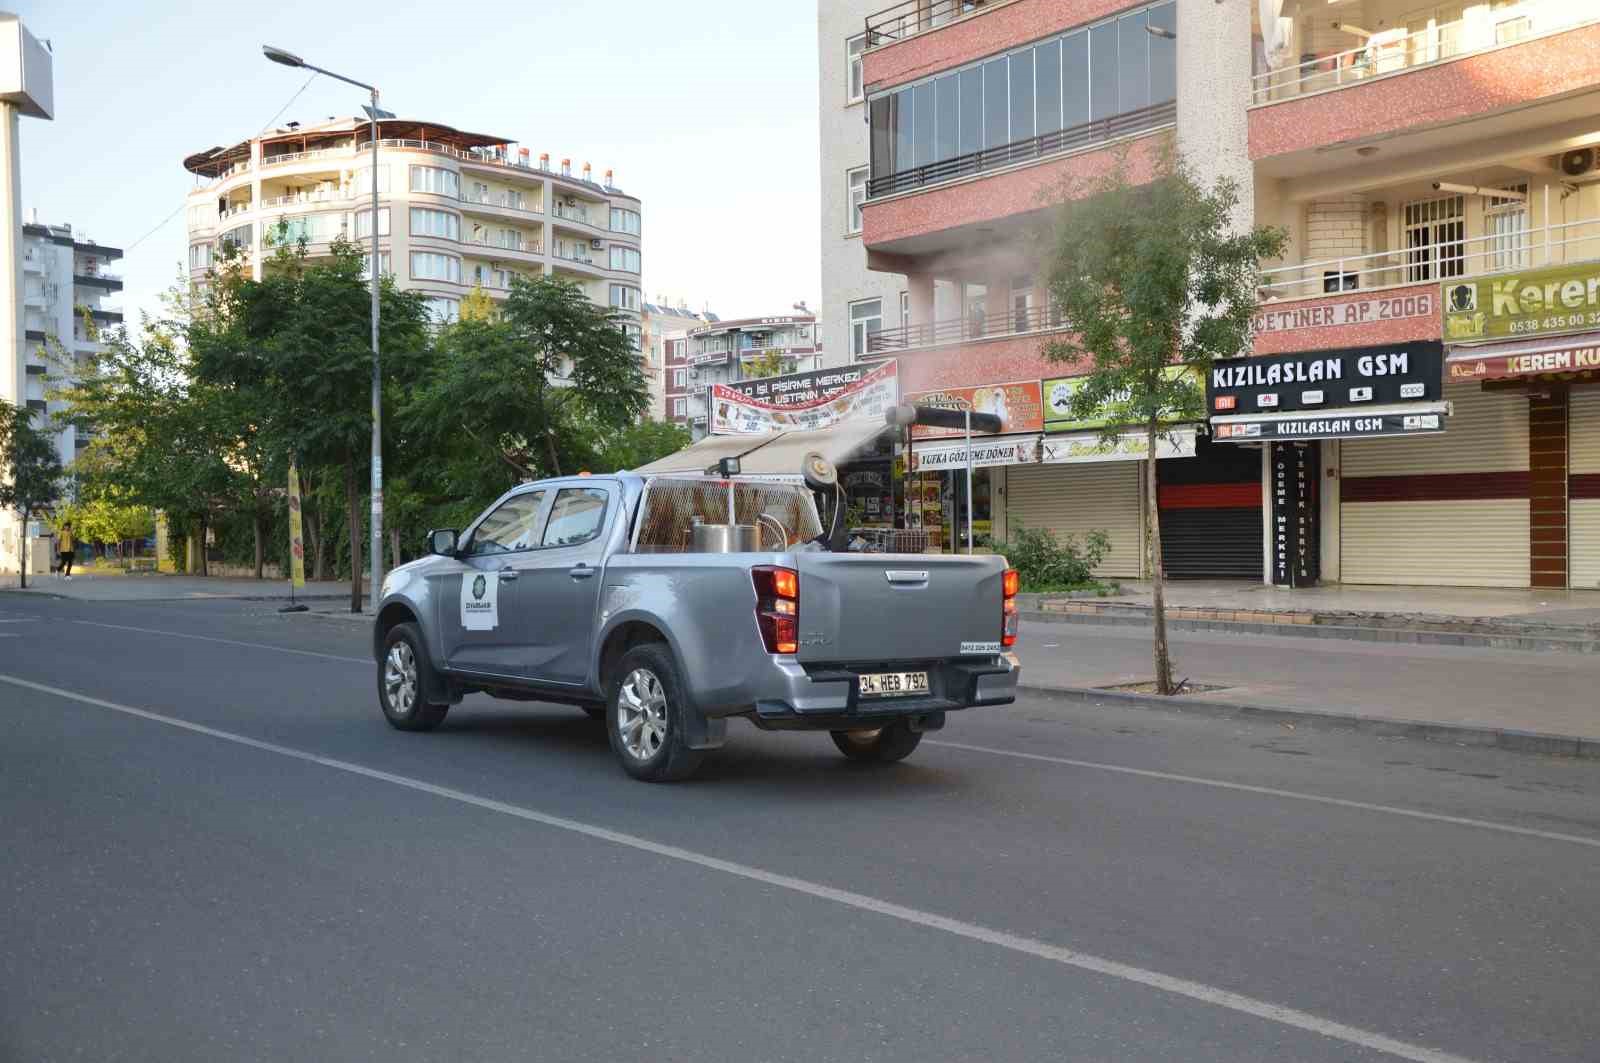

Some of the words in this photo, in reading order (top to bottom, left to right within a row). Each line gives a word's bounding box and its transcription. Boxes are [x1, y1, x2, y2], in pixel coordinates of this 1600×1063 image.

[1378, 296, 1430, 319] 2006
[1510, 320, 1538, 333] 0538
[1542, 316, 1566, 329] 435
[1569, 312, 1585, 326] 00
[1213, 358, 1341, 388] KIZILASLAN
[1357, 352, 1408, 377] GSM
[1507, 351, 1571, 373] KEREM
[1277, 420, 1351, 434] KIZILASLAN
[1355, 418, 1383, 432] GSM
[922, 453, 947, 465] YUFKA
[986, 445, 1015, 460] DÖNER
[861, 676, 874, 692] 34
[880, 674, 900, 691] HEB
[905, 673, 926, 689] 792
